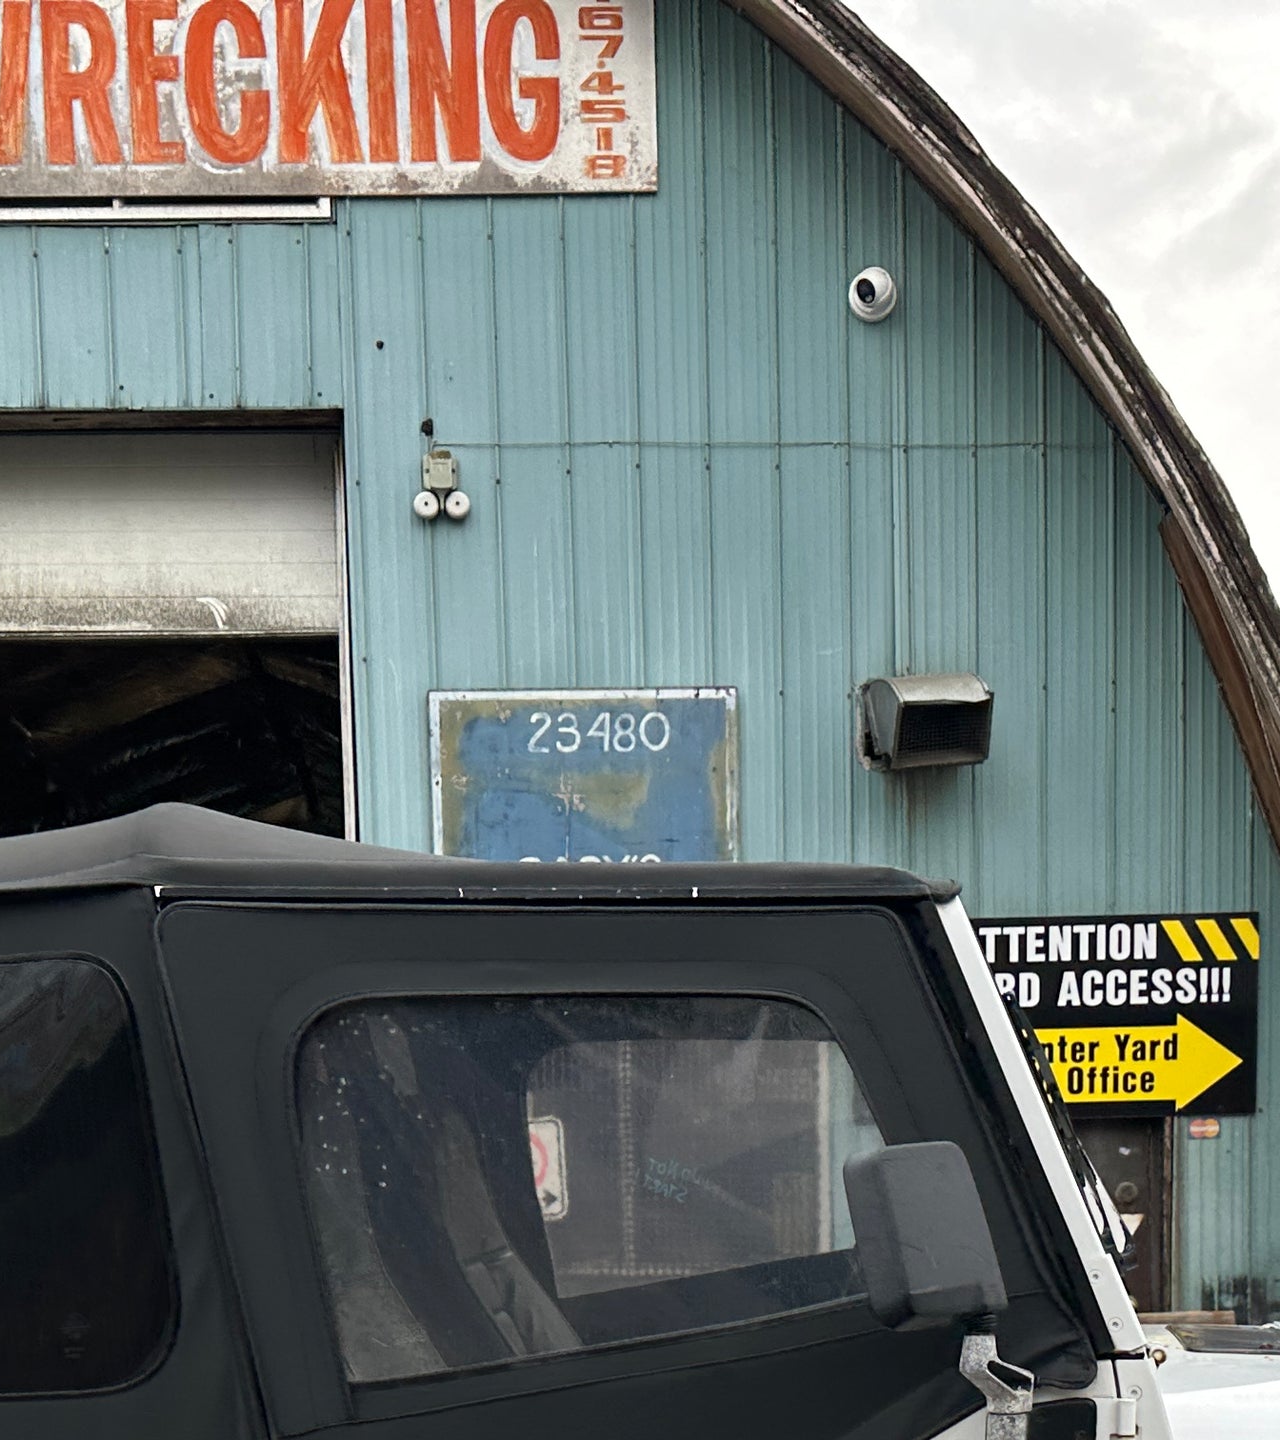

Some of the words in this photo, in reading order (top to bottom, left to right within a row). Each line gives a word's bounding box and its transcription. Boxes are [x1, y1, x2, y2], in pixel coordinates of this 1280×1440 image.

[527, 710, 671, 753] 23480
[978, 922, 1158, 963] TTENTION
[1056, 966, 1232, 1007] ACCESS!!!
[1040, 1035, 1100, 1063] nter
[1113, 1032, 1178, 1061] Yard
[1066, 1066, 1156, 1095] Office
